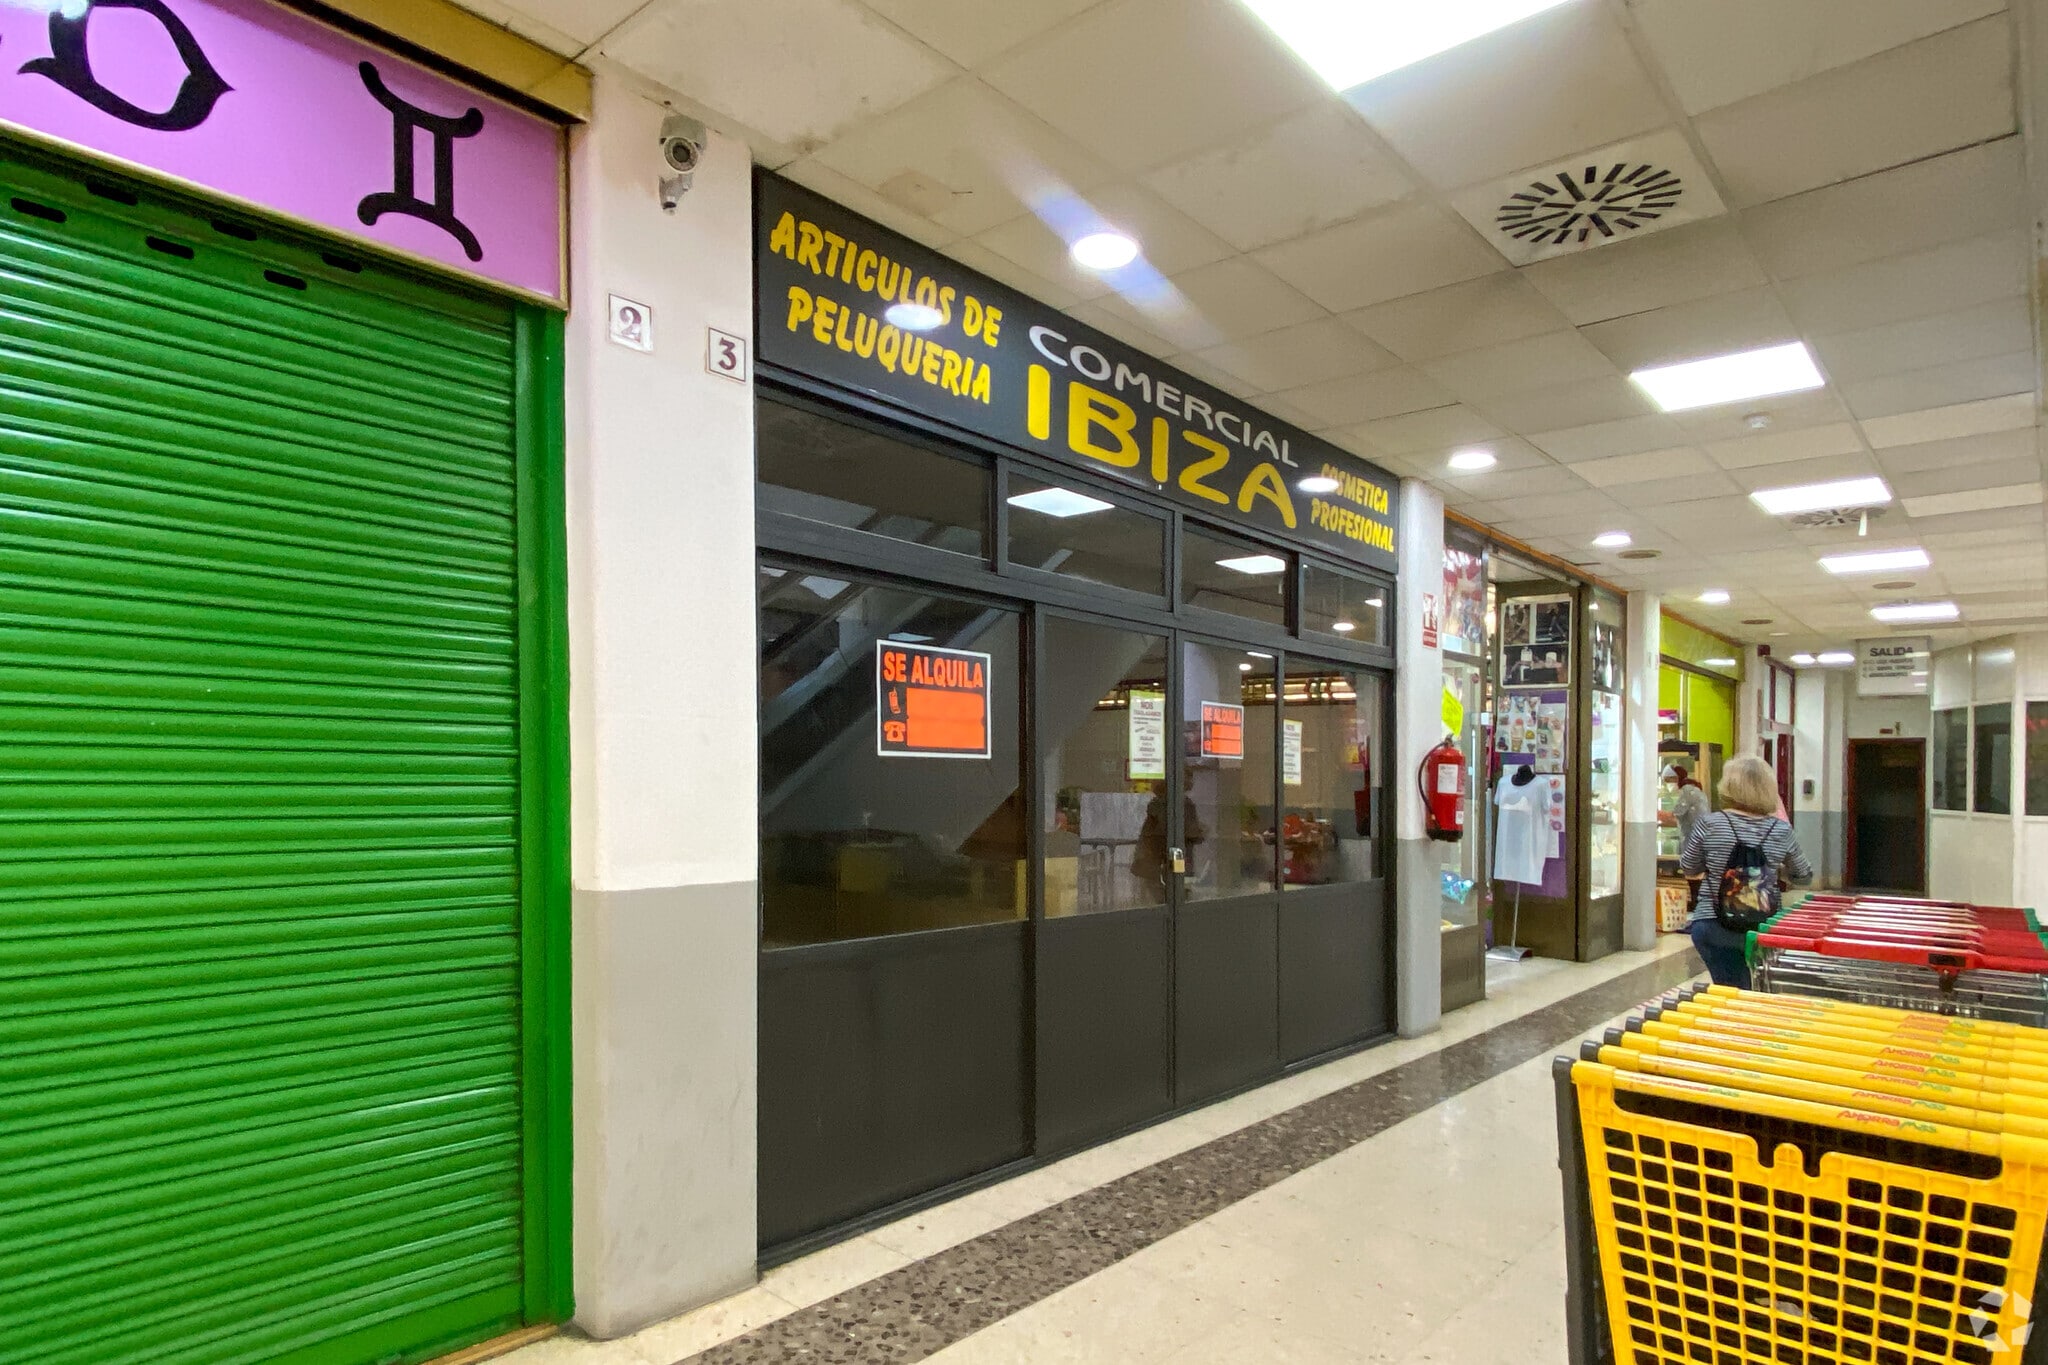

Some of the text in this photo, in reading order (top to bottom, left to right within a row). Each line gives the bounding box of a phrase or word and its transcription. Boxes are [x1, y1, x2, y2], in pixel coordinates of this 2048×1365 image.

[770, 211, 1003, 348] ARTICULOS DE
[619, 306, 642, 343] 2
[787, 286, 991, 404] PELUQUERIA
[718, 337, 737, 370] 3
[1028, 325, 1299, 468] COMERCIAL
[1027, 363, 1297, 529] IBIZA
[1310, 497, 1395, 553] PROFESIONAL
[883, 651, 984, 688] SE ALQUILA
[1869, 646, 1914, 656] SALIDA
[1203, 705, 1241, 725] SE ALQUILA
